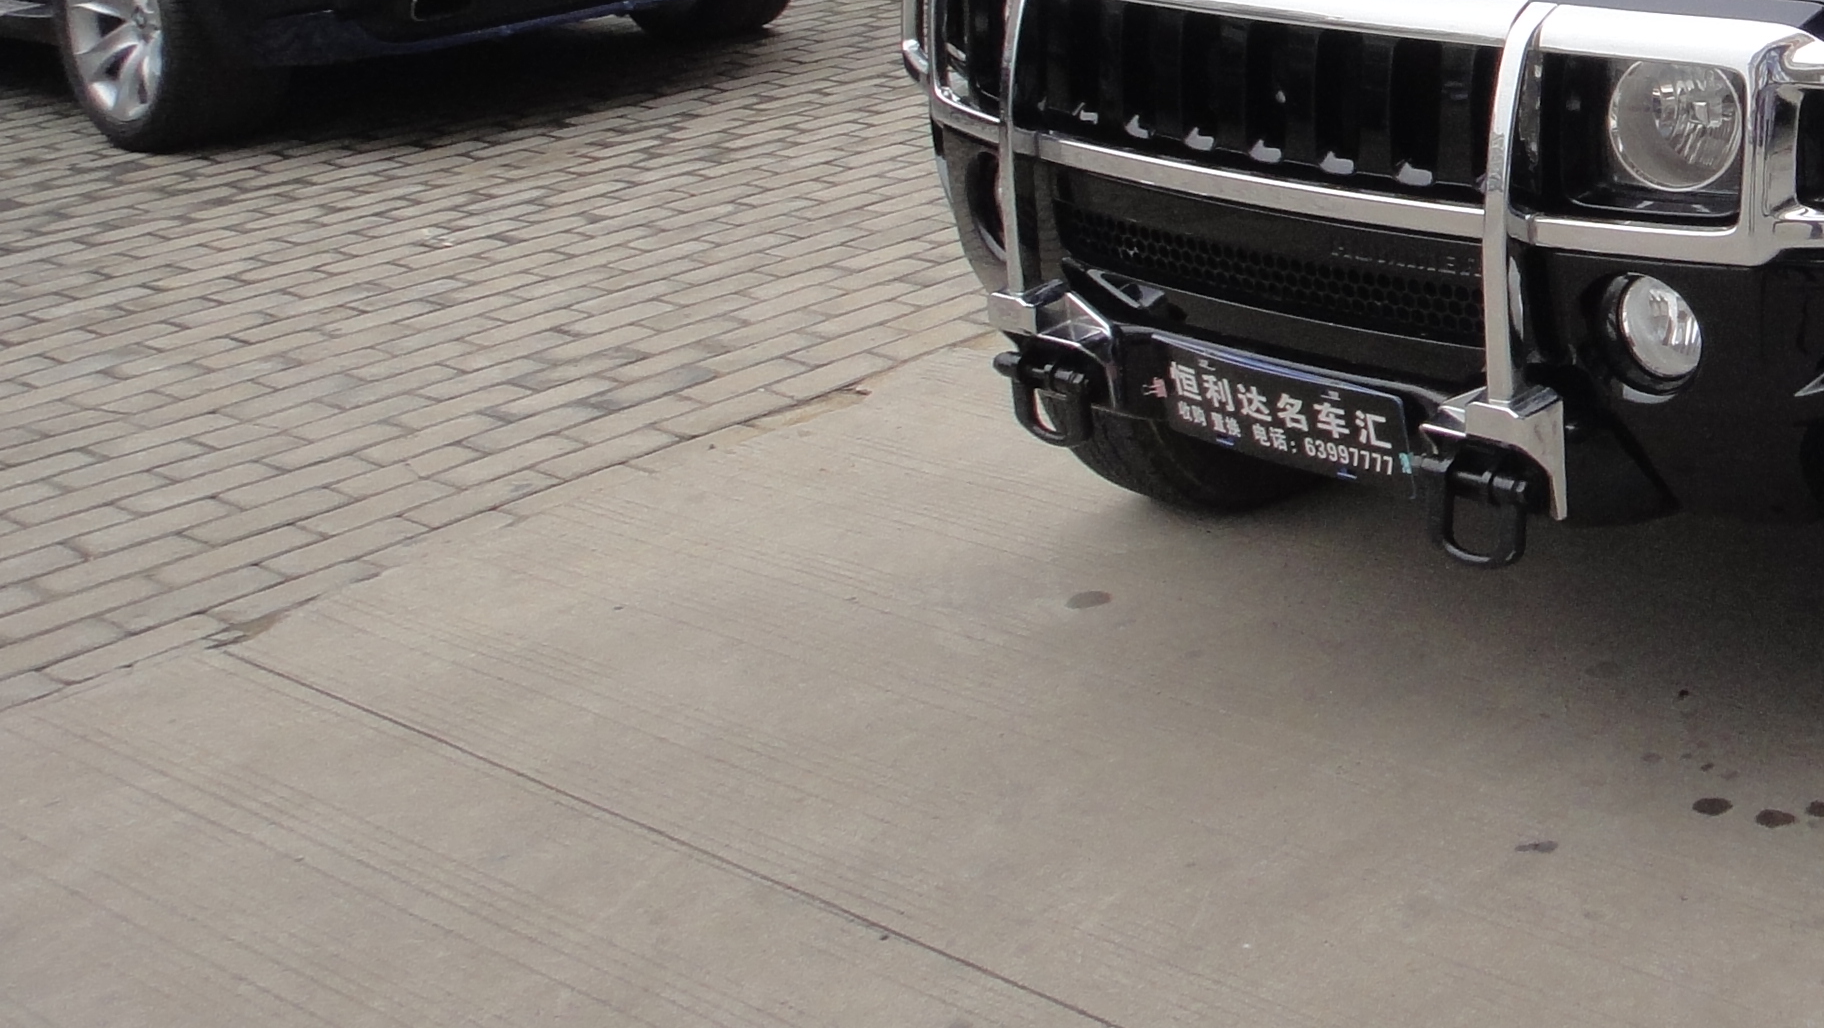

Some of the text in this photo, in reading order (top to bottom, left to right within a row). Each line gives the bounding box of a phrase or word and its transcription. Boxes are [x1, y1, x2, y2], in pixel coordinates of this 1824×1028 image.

[1169, 360, 1393, 451] 恒利达名车汇
